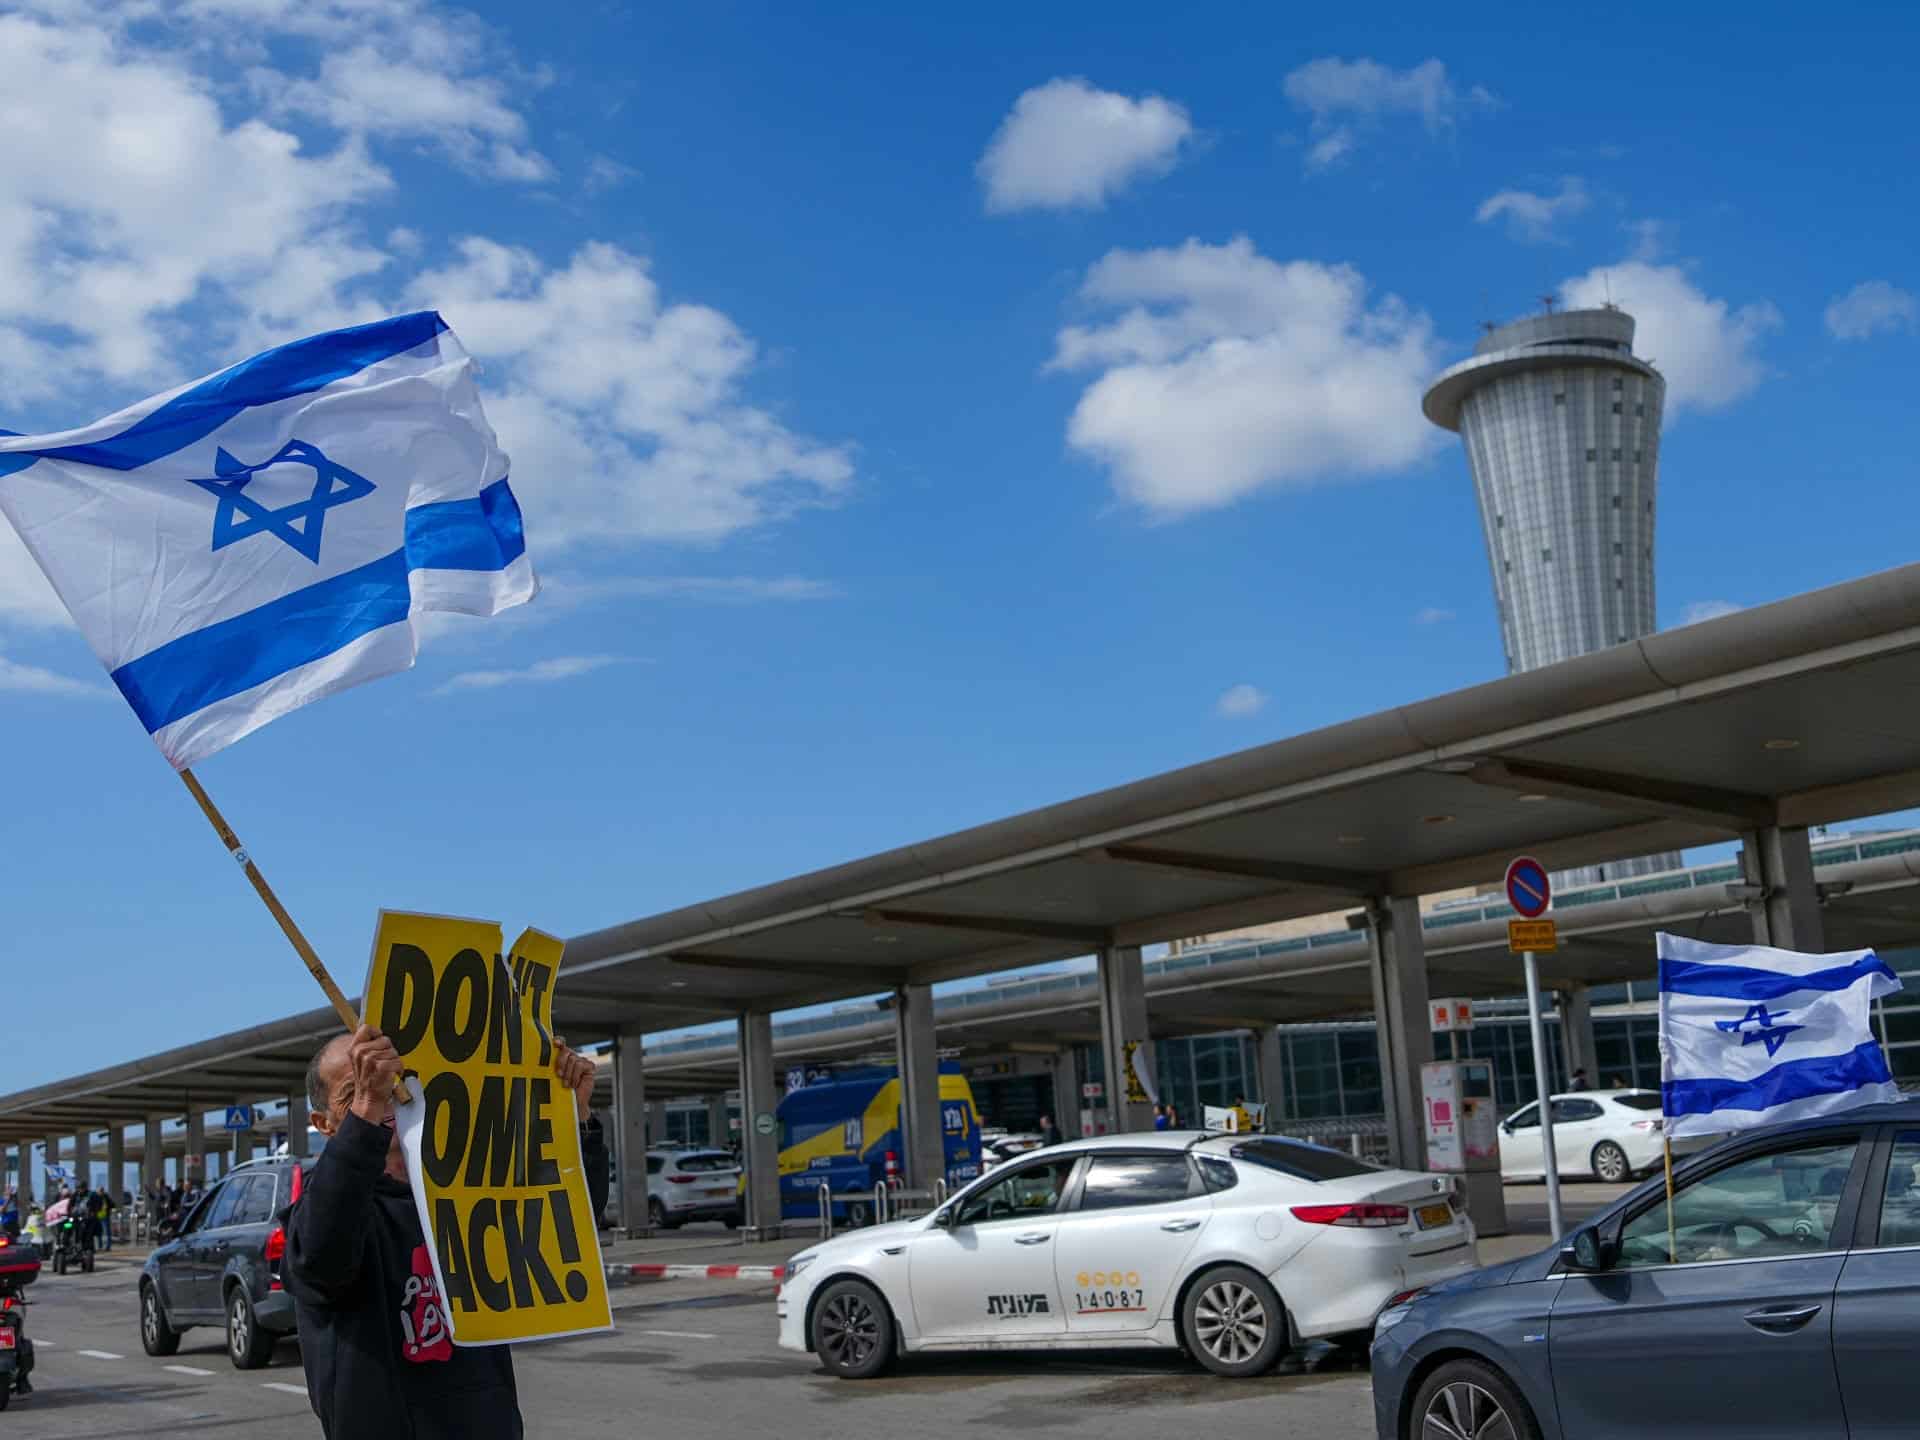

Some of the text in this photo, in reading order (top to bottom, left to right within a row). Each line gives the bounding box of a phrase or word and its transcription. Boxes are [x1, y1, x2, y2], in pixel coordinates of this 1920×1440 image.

[380, 943, 551, 1067] DON'T
[403, 1069, 561, 1188] OME
[436, 1189, 588, 1313] ACK!
